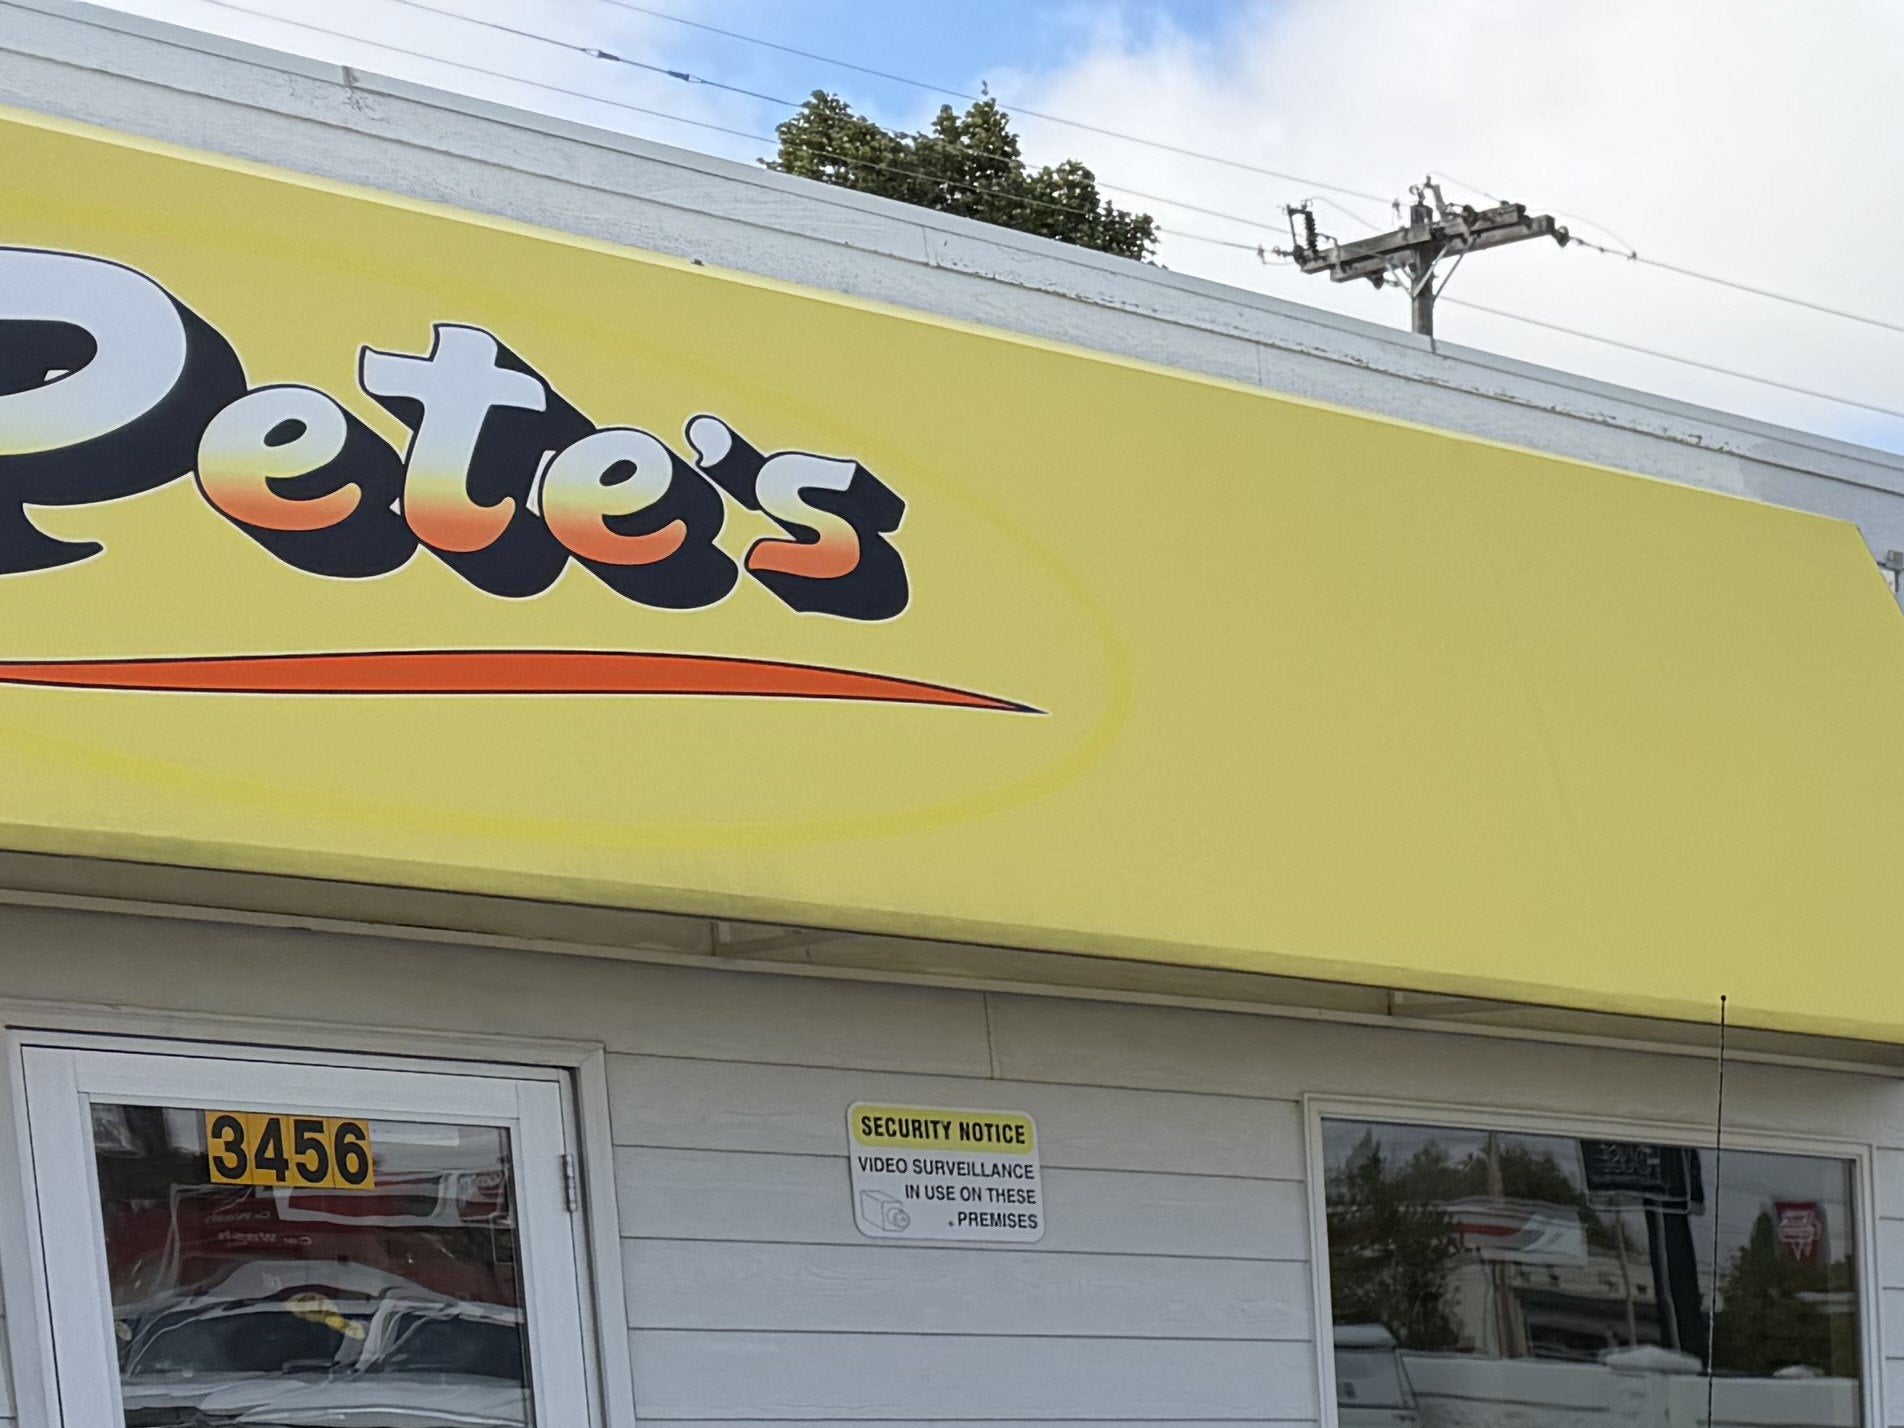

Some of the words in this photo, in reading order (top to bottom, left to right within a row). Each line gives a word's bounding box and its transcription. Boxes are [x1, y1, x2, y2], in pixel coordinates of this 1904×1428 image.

[861, 1115, 951, 1141] SECURITY
[959, 1121, 1026, 1145] NOTICE
[209, 1114, 370, 1186] 3456
[858, 1156, 908, 1174] VIDEO
[912, 1159, 1035, 1180] SURVEILLANCE
[905, 1184, 920, 1200] IN
[924, 1186, 955, 1201] USE
[960, 1186, 982, 1202] ON
[987, 1187, 1036, 1204] THESE
[957, 1211, 1039, 1229] PREMISES
